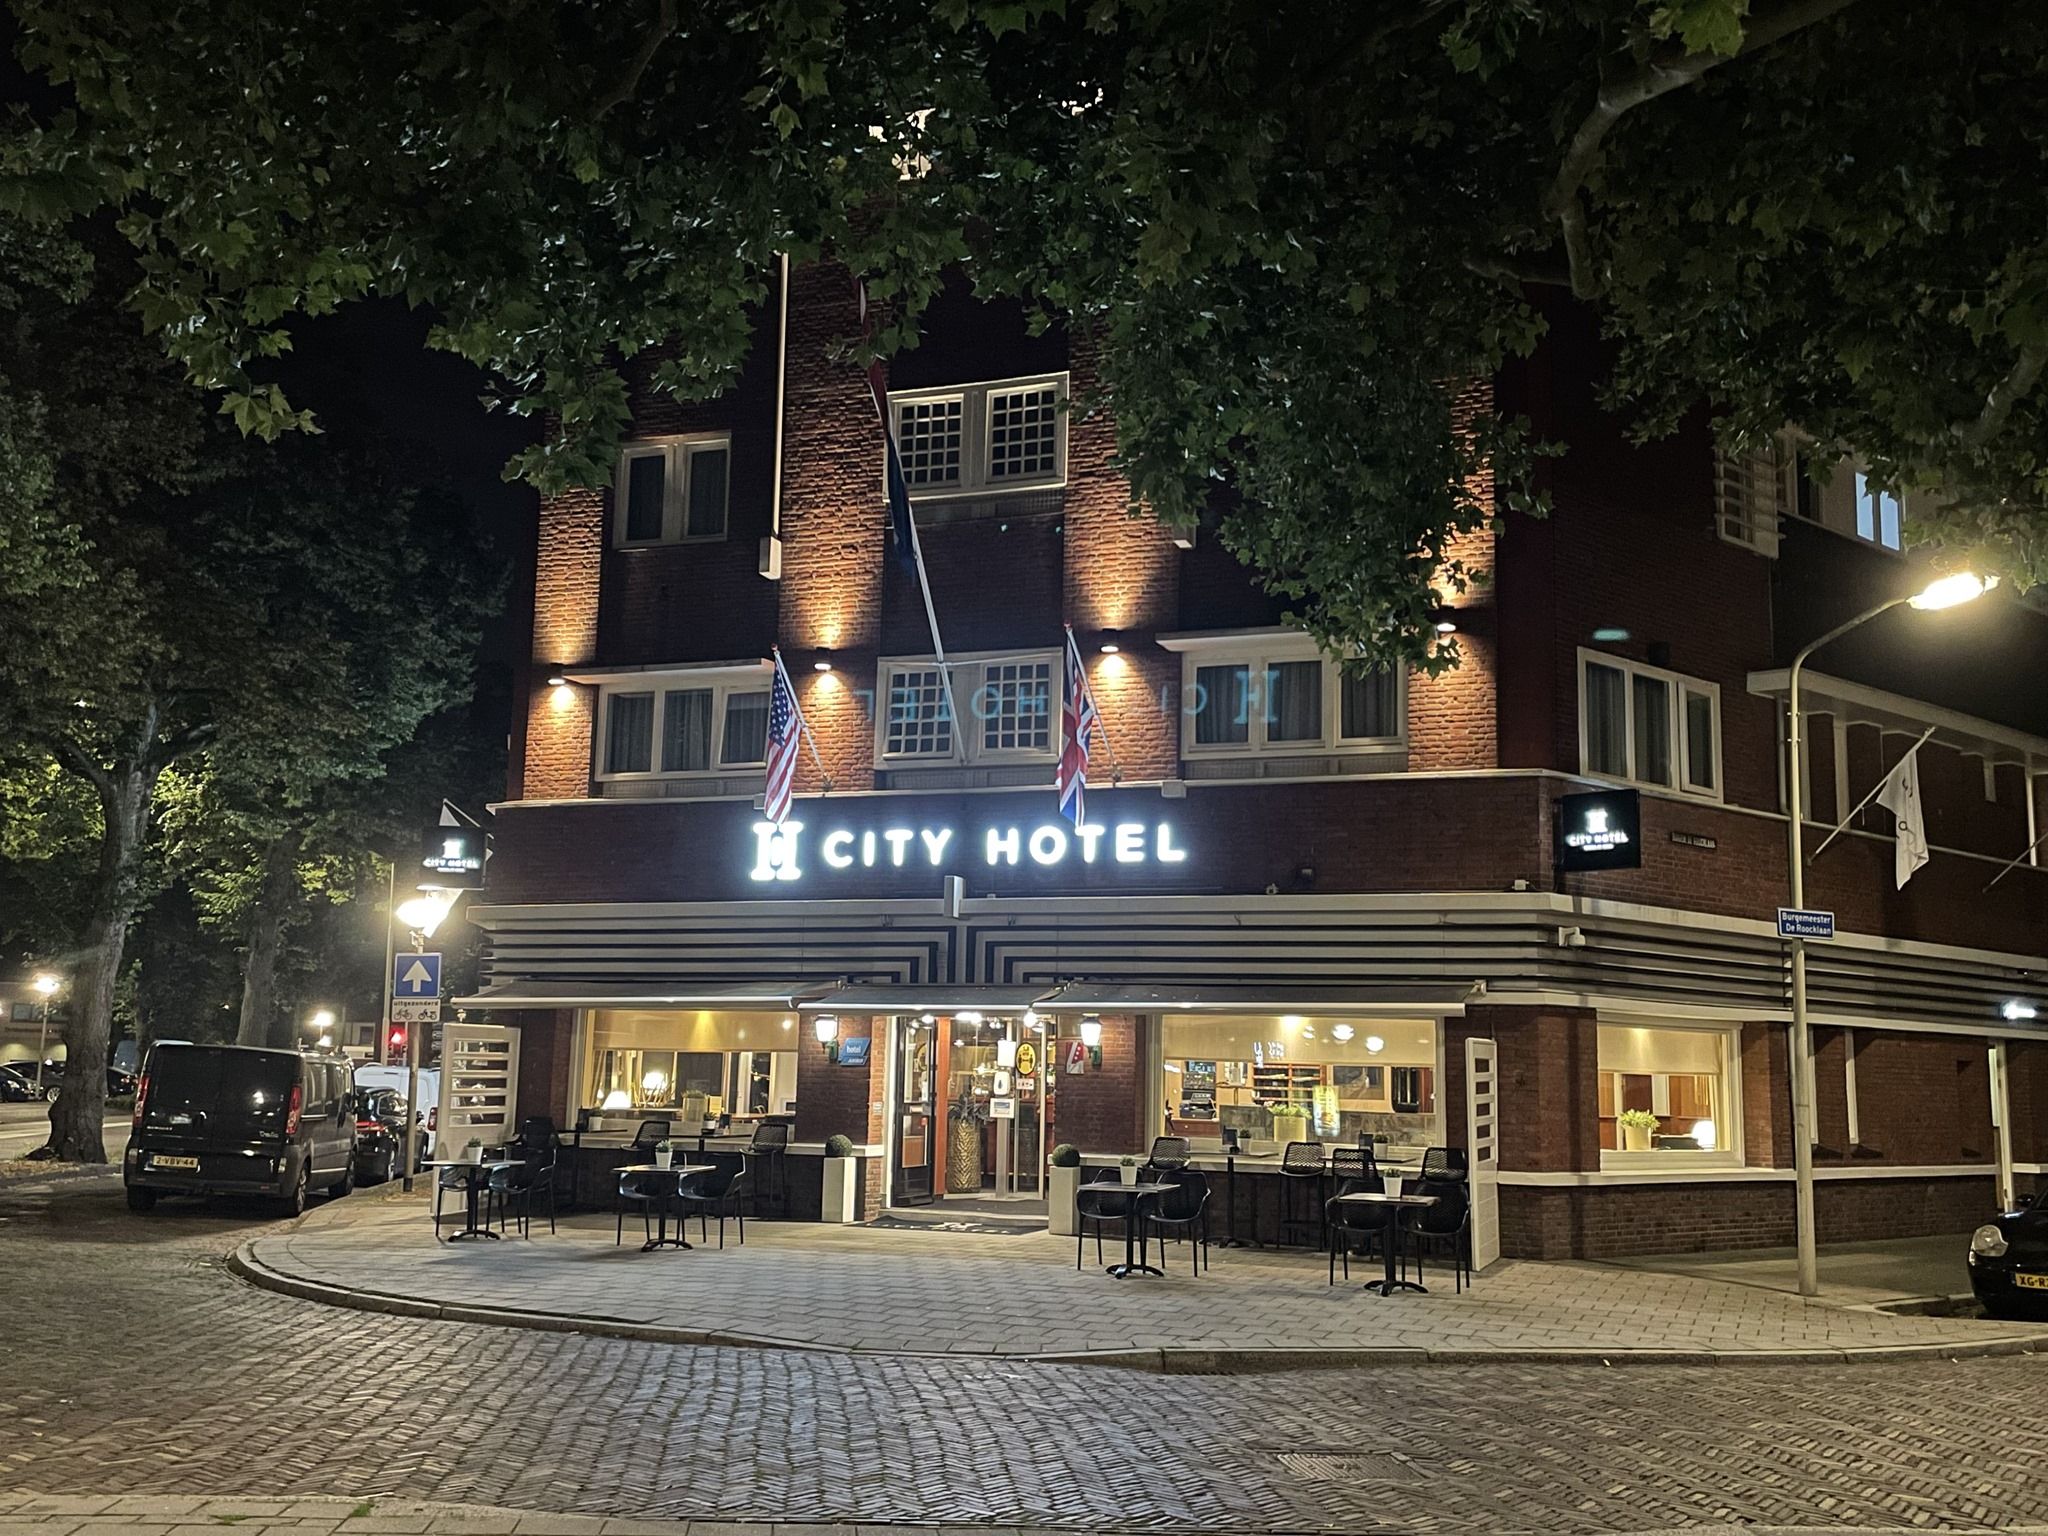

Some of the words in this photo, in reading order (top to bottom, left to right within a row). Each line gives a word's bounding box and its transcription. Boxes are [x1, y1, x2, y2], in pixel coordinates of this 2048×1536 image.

[823, 828, 952, 868] CITY
[987, 823, 1186, 866] HOTEL
[1781, 912, 1831, 924] Burgemeester
[1785, 923, 1795, 932] De
